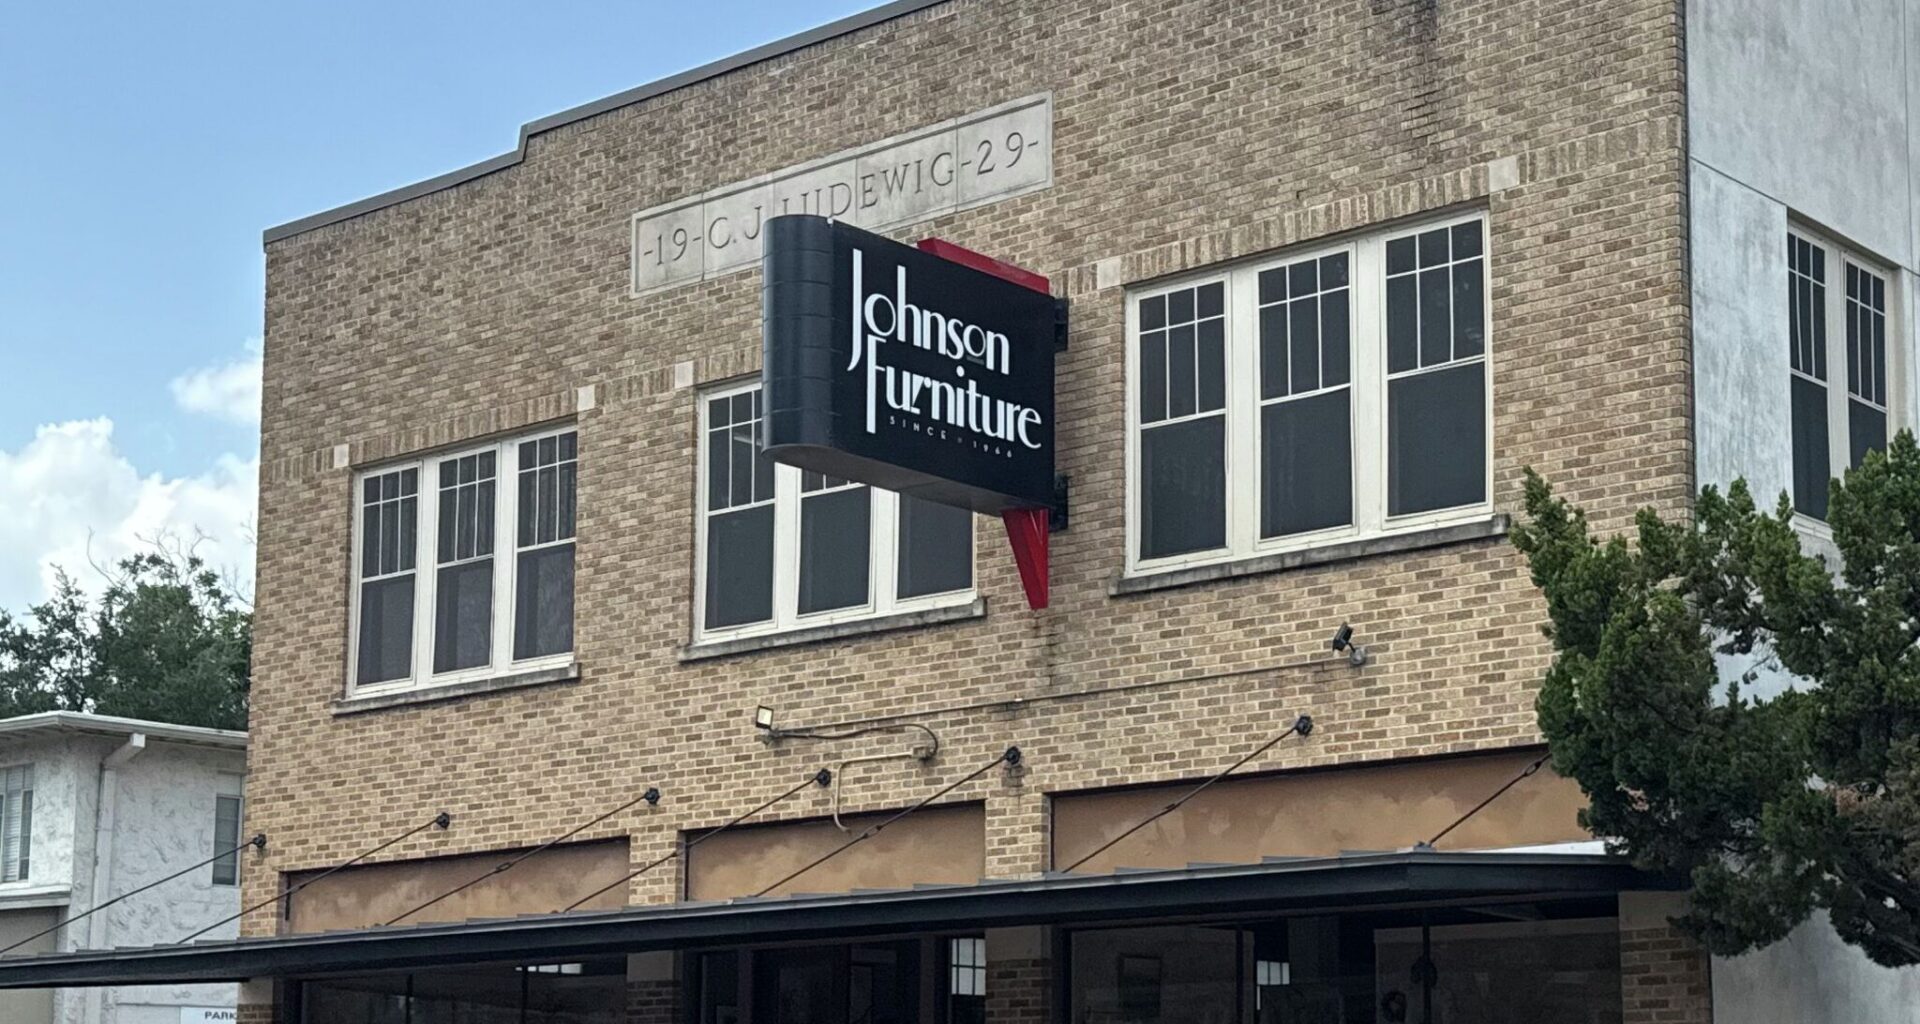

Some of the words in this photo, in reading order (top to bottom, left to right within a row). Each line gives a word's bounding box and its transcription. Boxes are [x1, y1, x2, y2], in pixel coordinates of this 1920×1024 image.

[847, 248, 1010, 375] Johnson
[866, 334, 1042, 449] Furniture
[889, 415, 946, 440] SINCE
